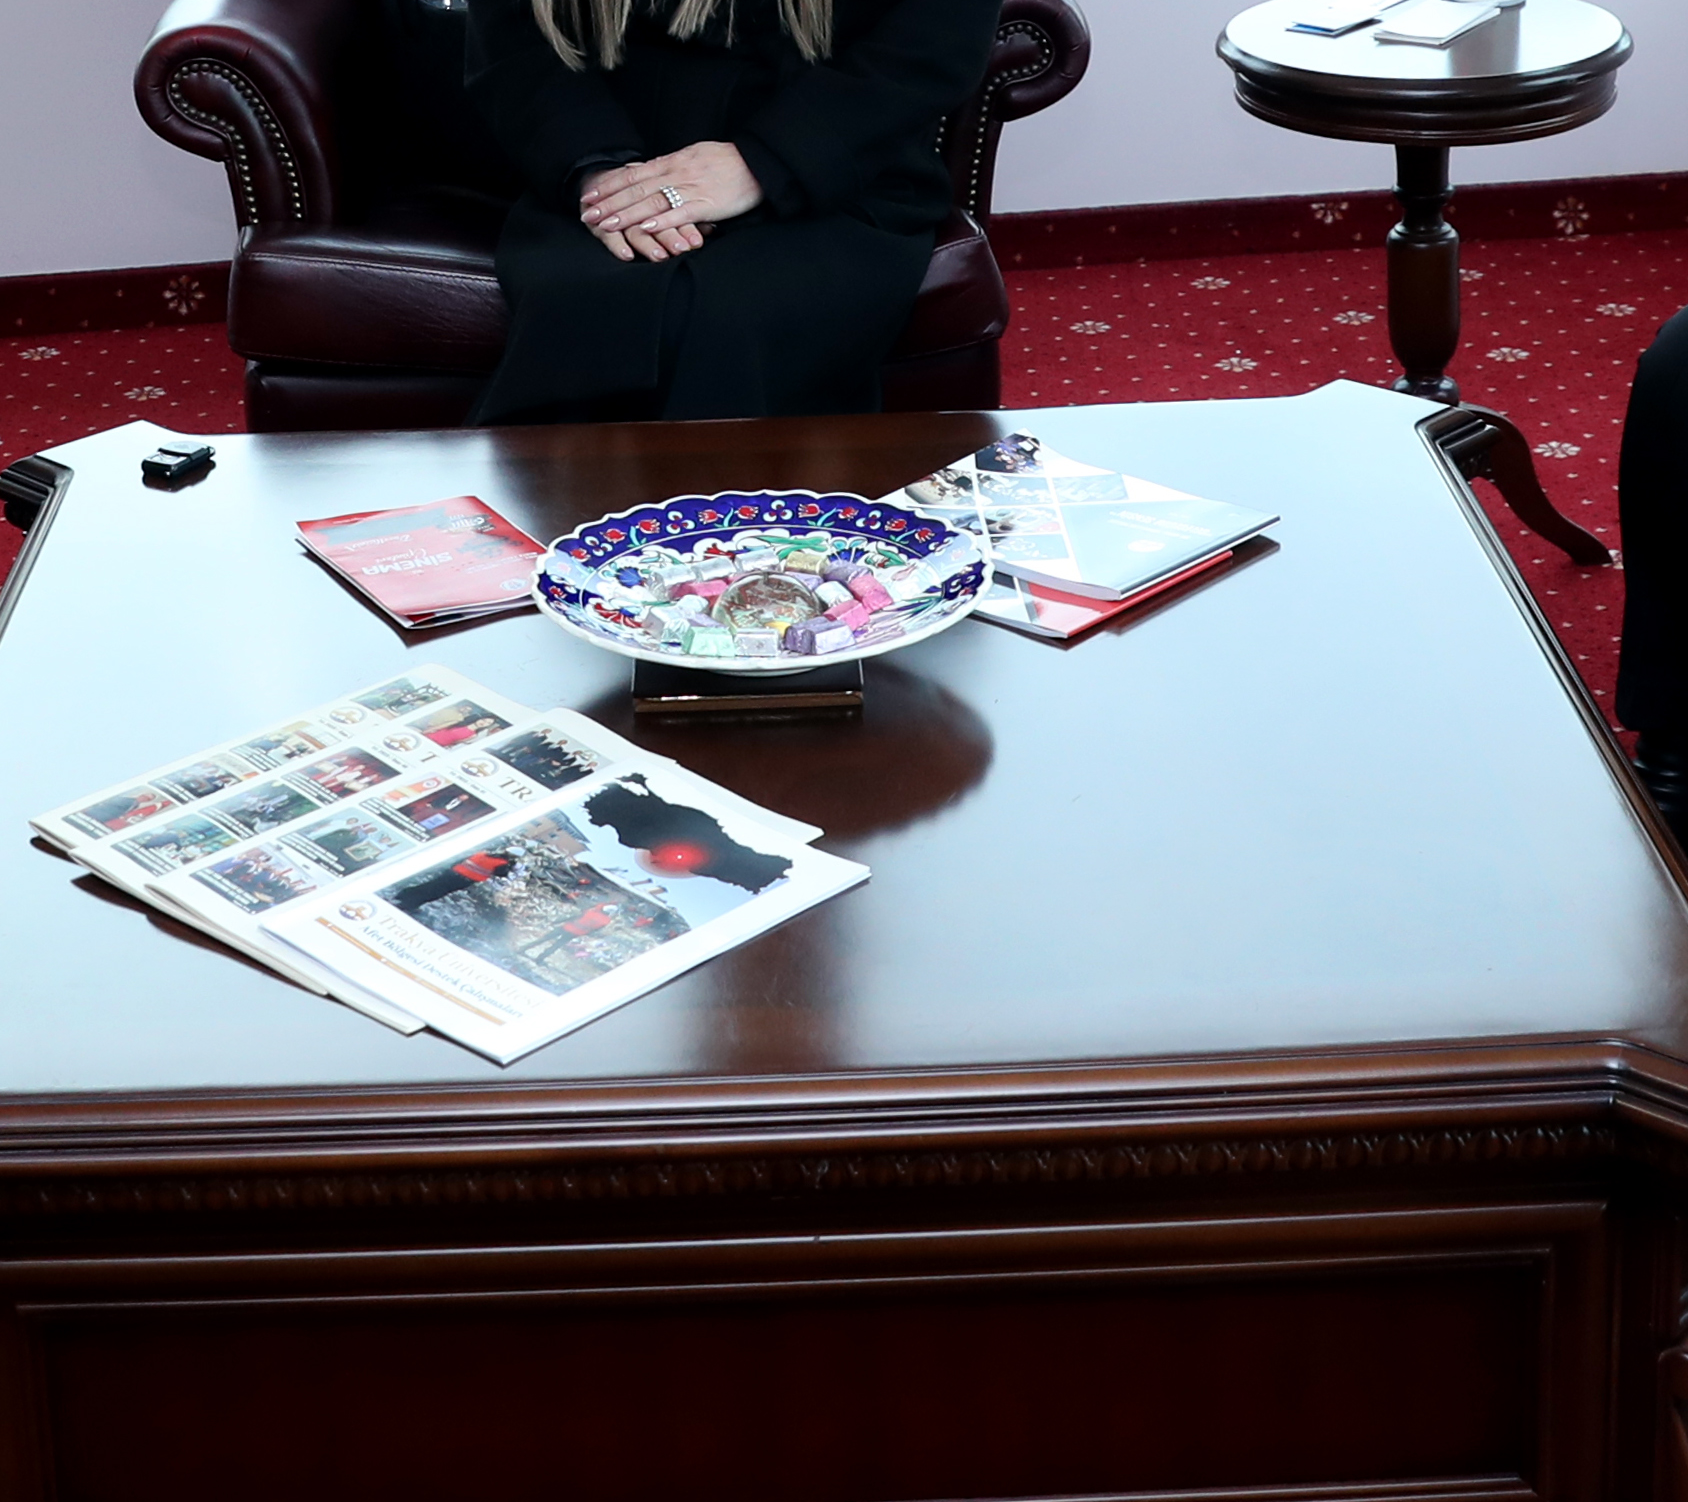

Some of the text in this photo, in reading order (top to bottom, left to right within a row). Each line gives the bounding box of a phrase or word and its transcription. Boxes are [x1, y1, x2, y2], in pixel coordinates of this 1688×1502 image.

[361, 551, 454, 576] SİNEMA
[360, 924, 385, 943] Afet
[382, 939, 425, 967] Bölgesi
[422, 960, 460, 987] Destek
[458, 983, 525, 1019] Çalışmaları
[377, 913, 437, 955] Trakya
[438, 949, 544, 1009] Üniversitesi
